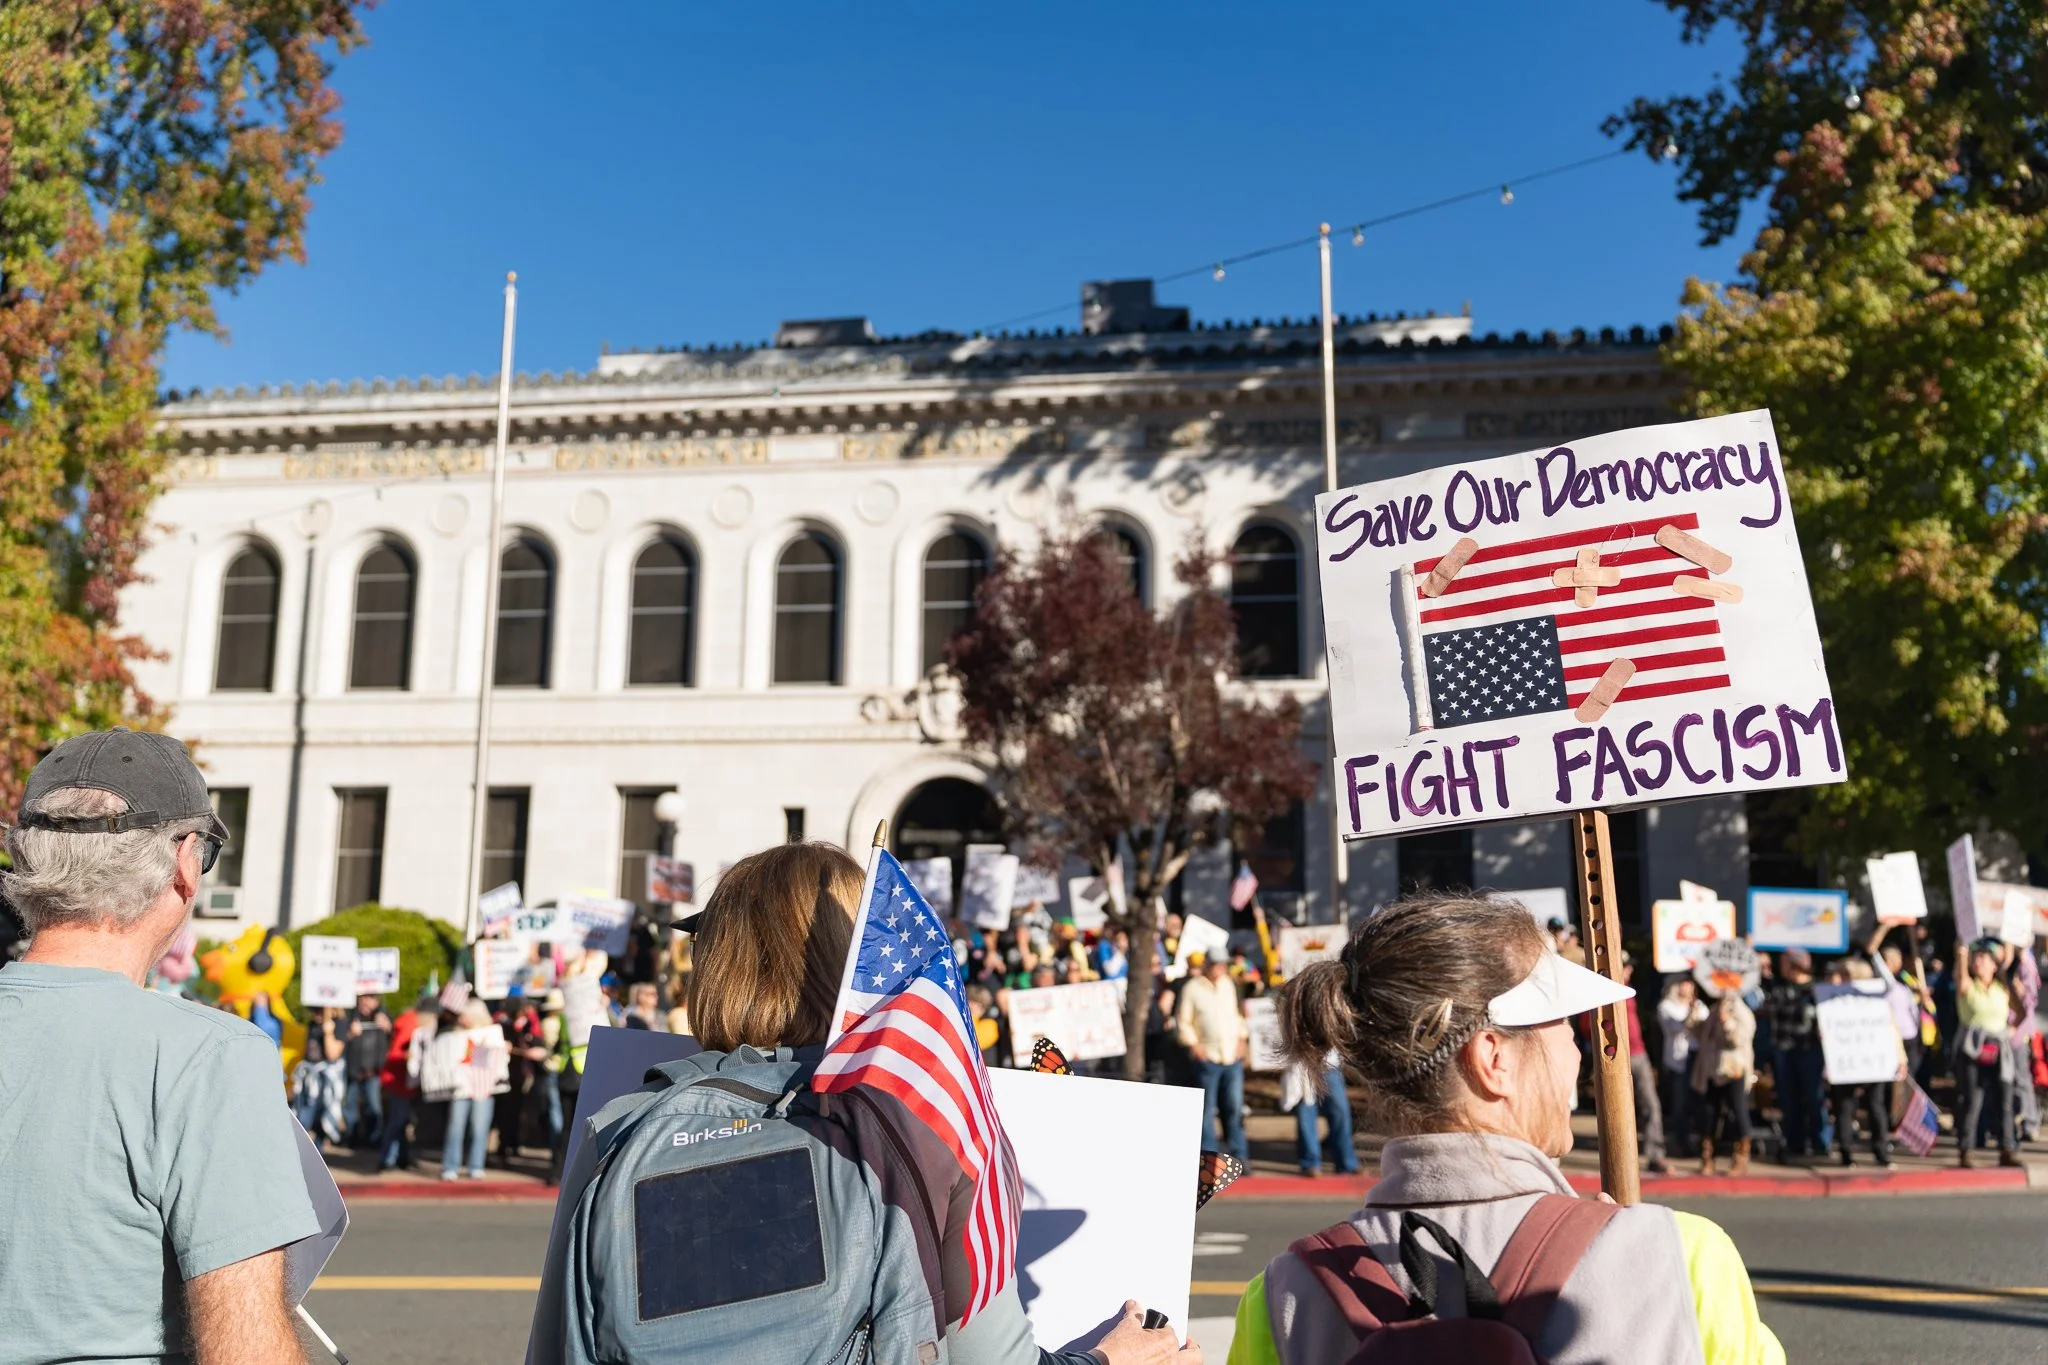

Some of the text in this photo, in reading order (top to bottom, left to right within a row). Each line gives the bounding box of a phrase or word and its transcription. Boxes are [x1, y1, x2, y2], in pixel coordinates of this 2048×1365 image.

[1325, 441, 1782, 562] Save Our Democracy
[1344, 697, 1841, 832] FIGHT FASCISM
